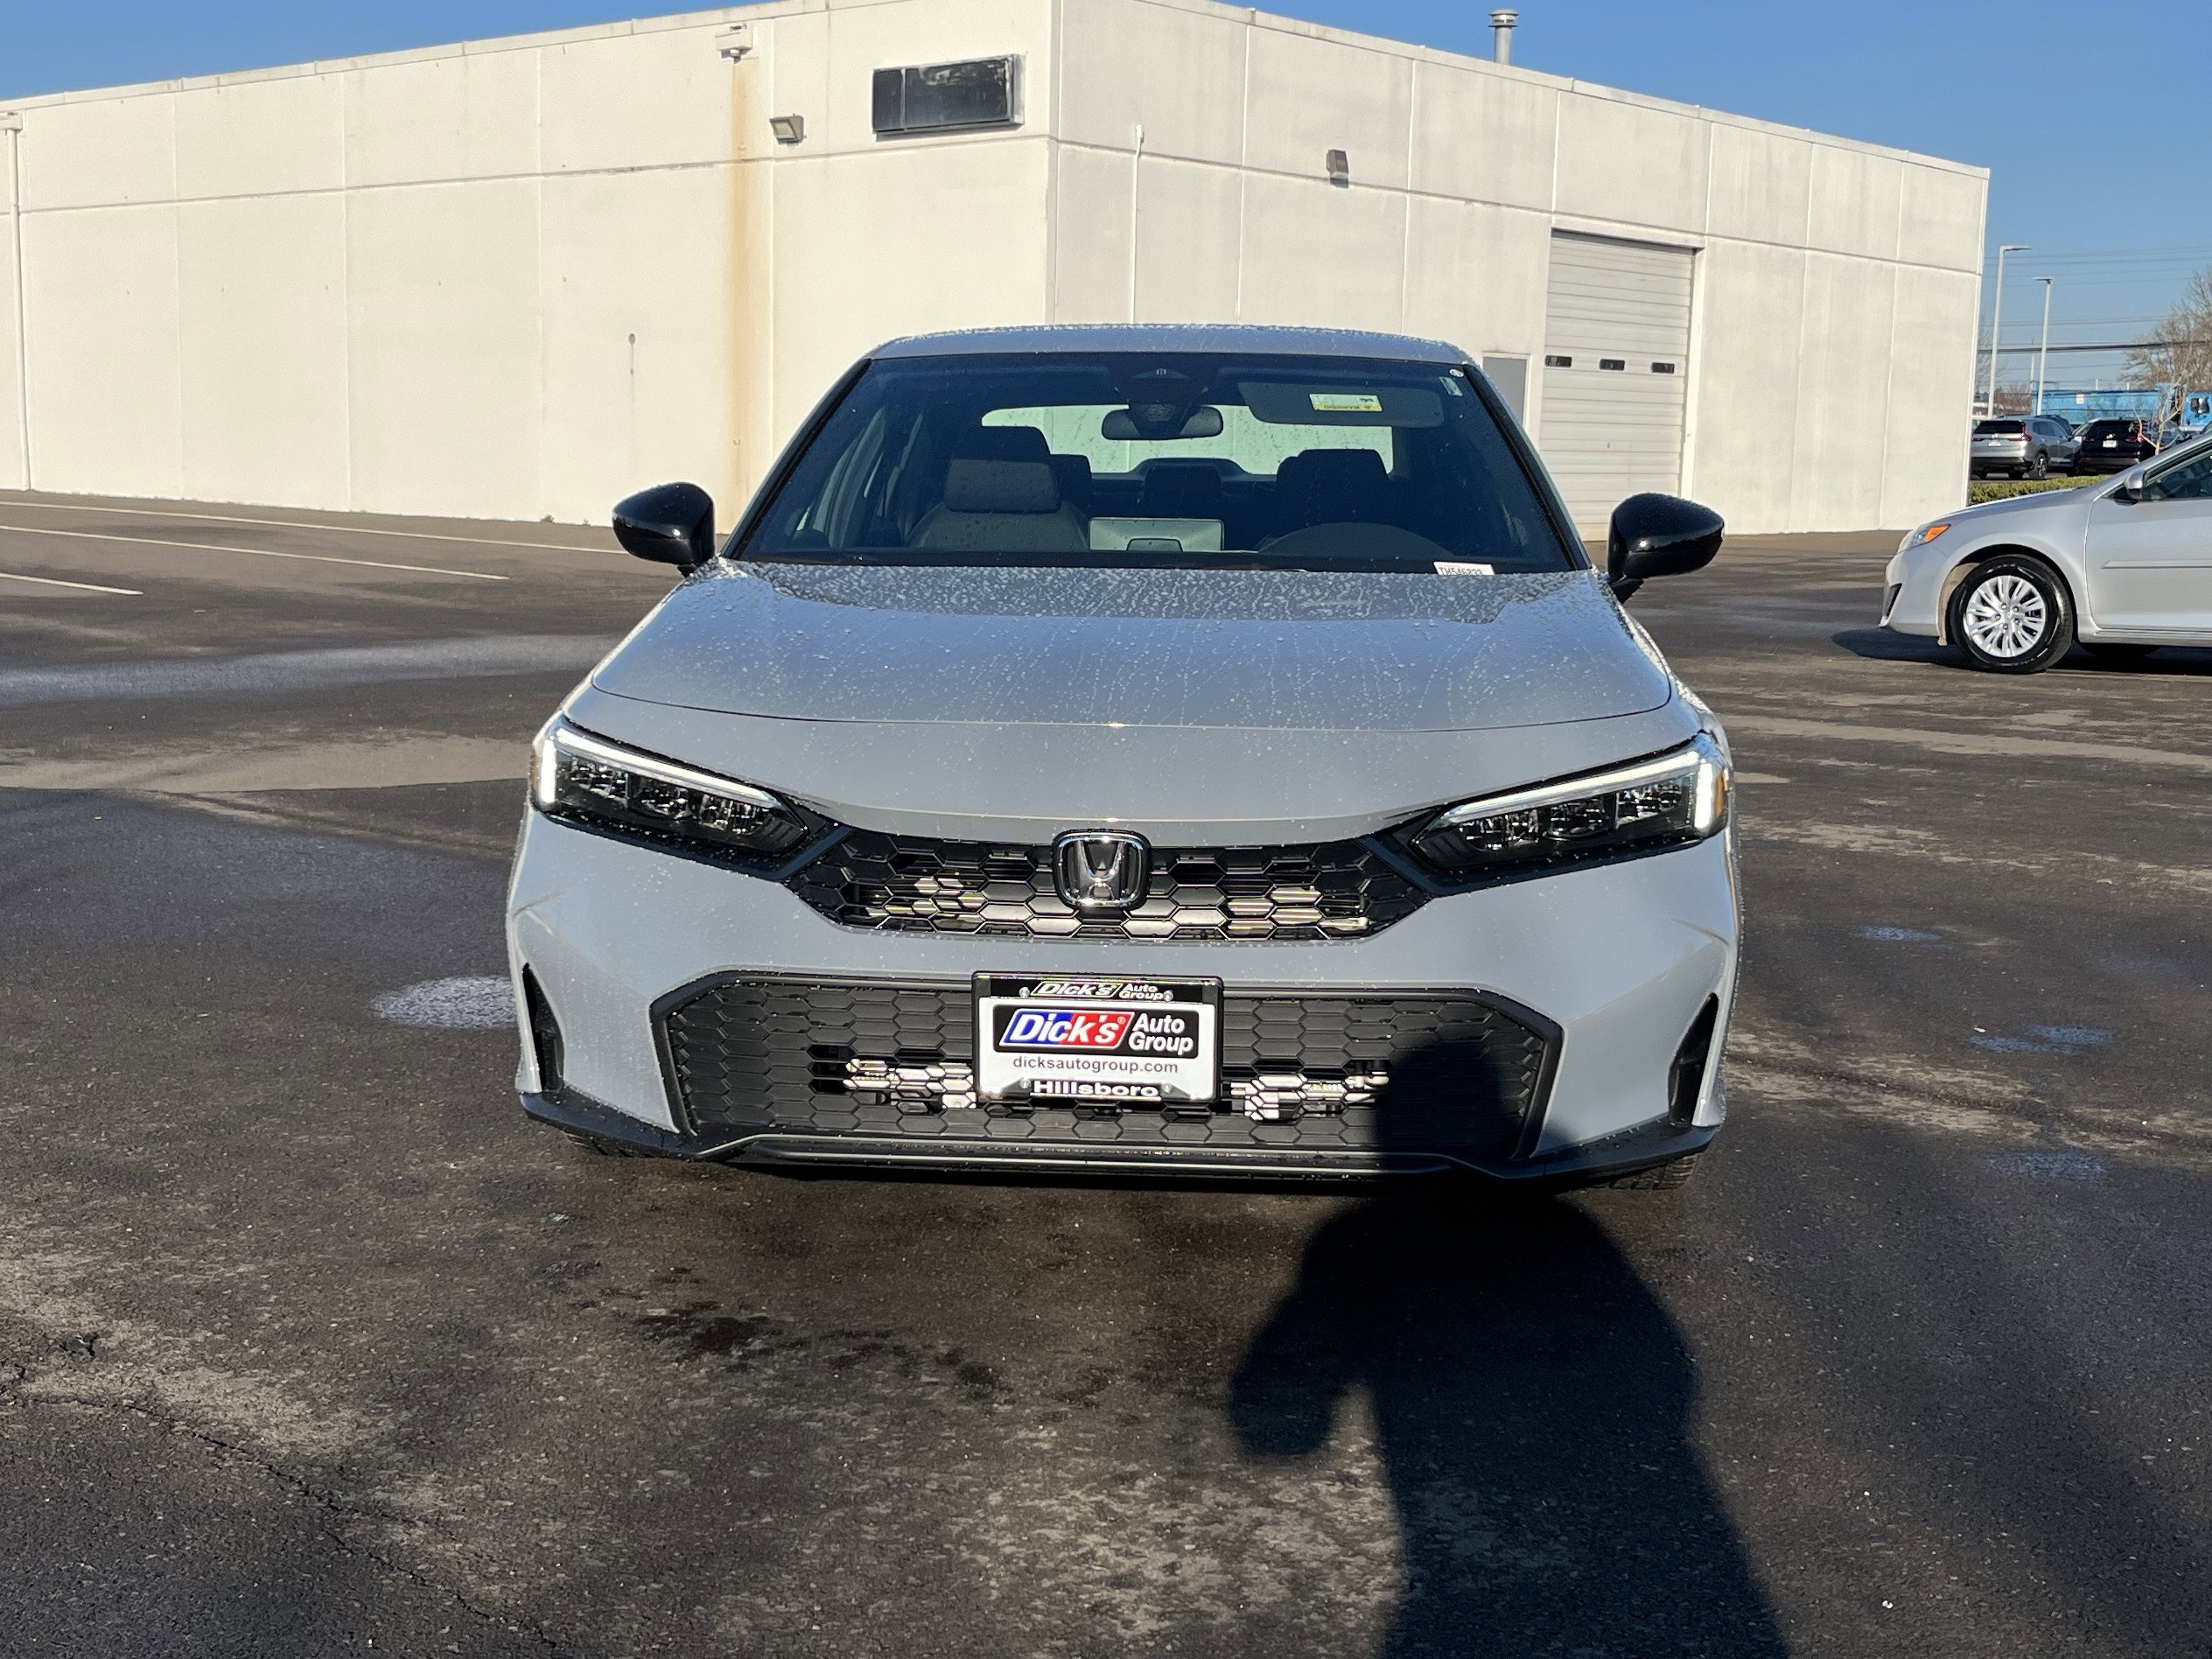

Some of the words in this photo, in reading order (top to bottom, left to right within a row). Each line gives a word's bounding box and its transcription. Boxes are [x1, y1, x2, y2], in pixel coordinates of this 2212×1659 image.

[1037, 983, 1114, 996] Dick's
[1119, 990, 1164, 1001] Group
[1124, 983, 1159, 992] Auto
[1009, 1012, 1120, 1043] Dick's
[1132, 1013, 1186, 1034] Auto
[1128, 1031, 1194, 1056] Group
[1013, 1056, 1178, 1074] dicksautogroup.com
[1034, 1080, 1159, 1097] Hillsboro
